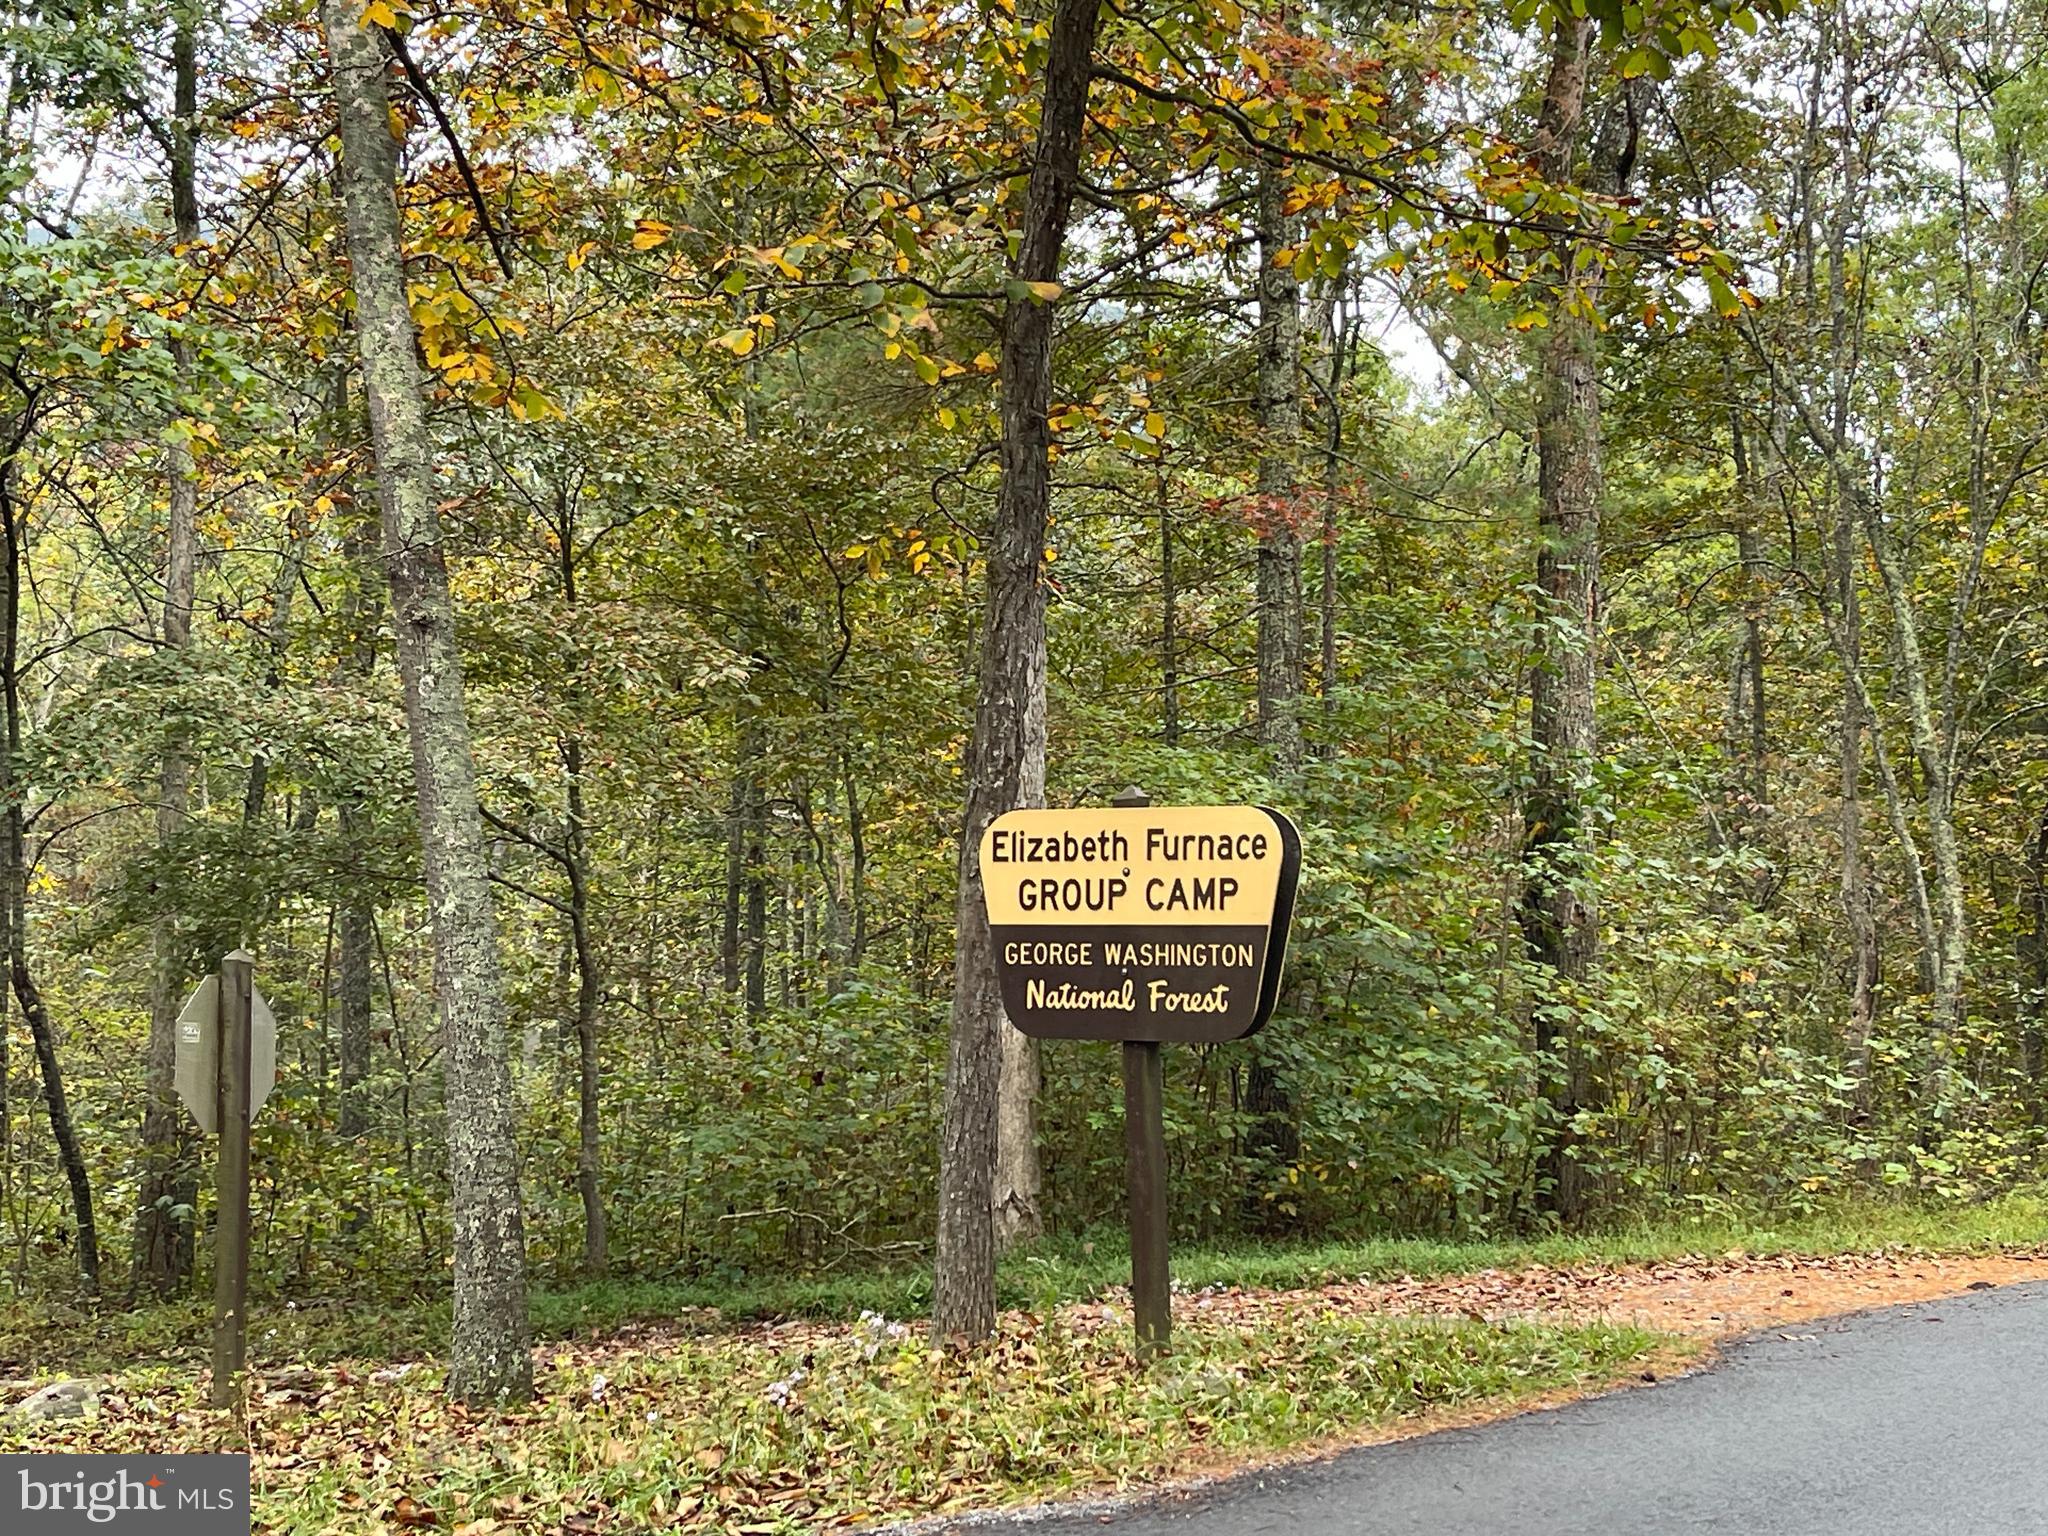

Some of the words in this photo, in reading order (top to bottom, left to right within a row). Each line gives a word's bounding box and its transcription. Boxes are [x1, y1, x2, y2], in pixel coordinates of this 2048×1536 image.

[992, 830, 1128, 862] Elizabeth
[1147, 828, 1267, 861] Furnace
[1018, 878, 1127, 911] GROUP
[1146, 878, 1239, 911] CAMP
[1005, 943, 1092, 965] GEORGE
[1105, 943, 1254, 967] WASHINGTON
[1026, 979, 1135, 1011] National
[1147, 980, 1230, 1013] Forest
